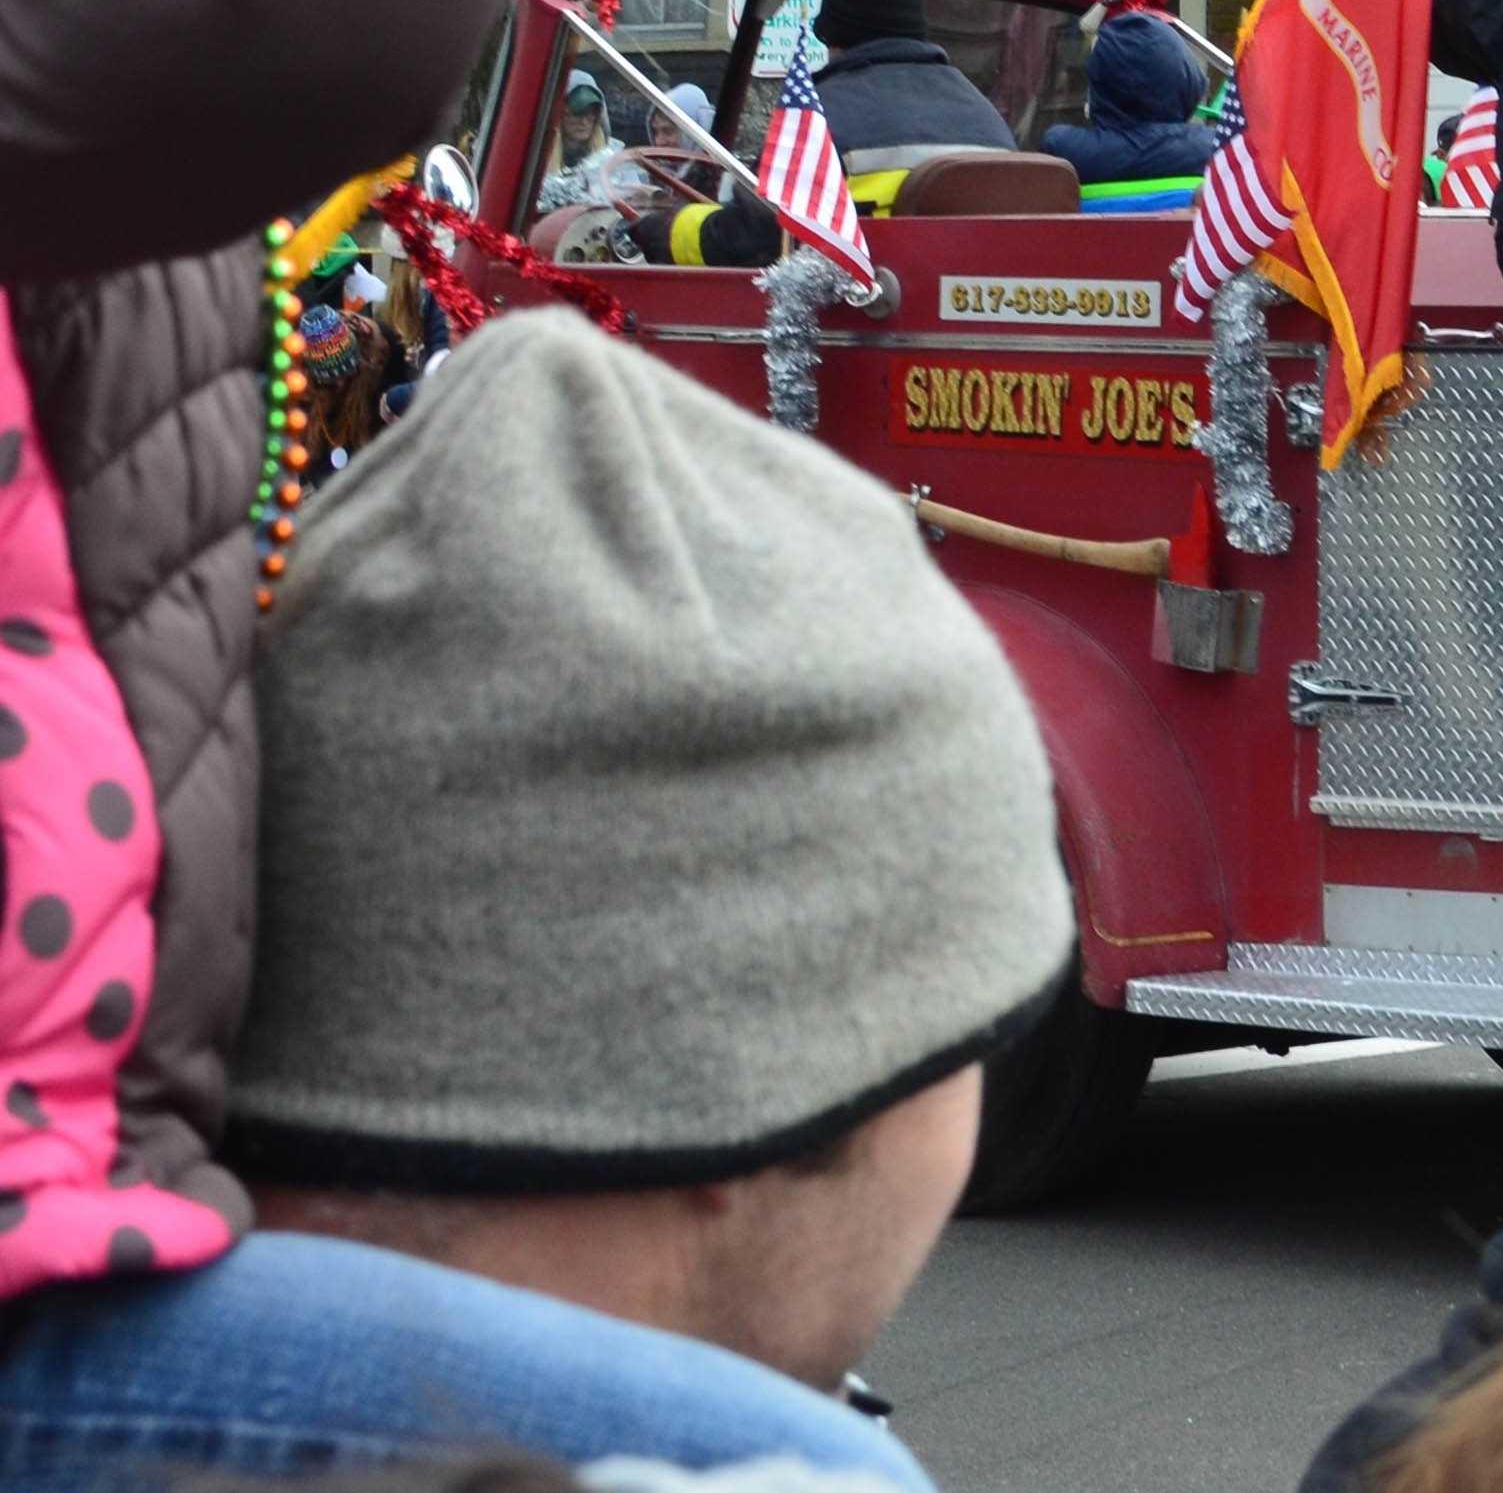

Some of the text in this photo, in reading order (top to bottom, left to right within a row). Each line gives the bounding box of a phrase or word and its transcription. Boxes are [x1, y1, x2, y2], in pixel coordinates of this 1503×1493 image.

[1318, 7, 1378, 102] MARINE
[905, 364, 1197, 448] SMOKIN' JOE'S
